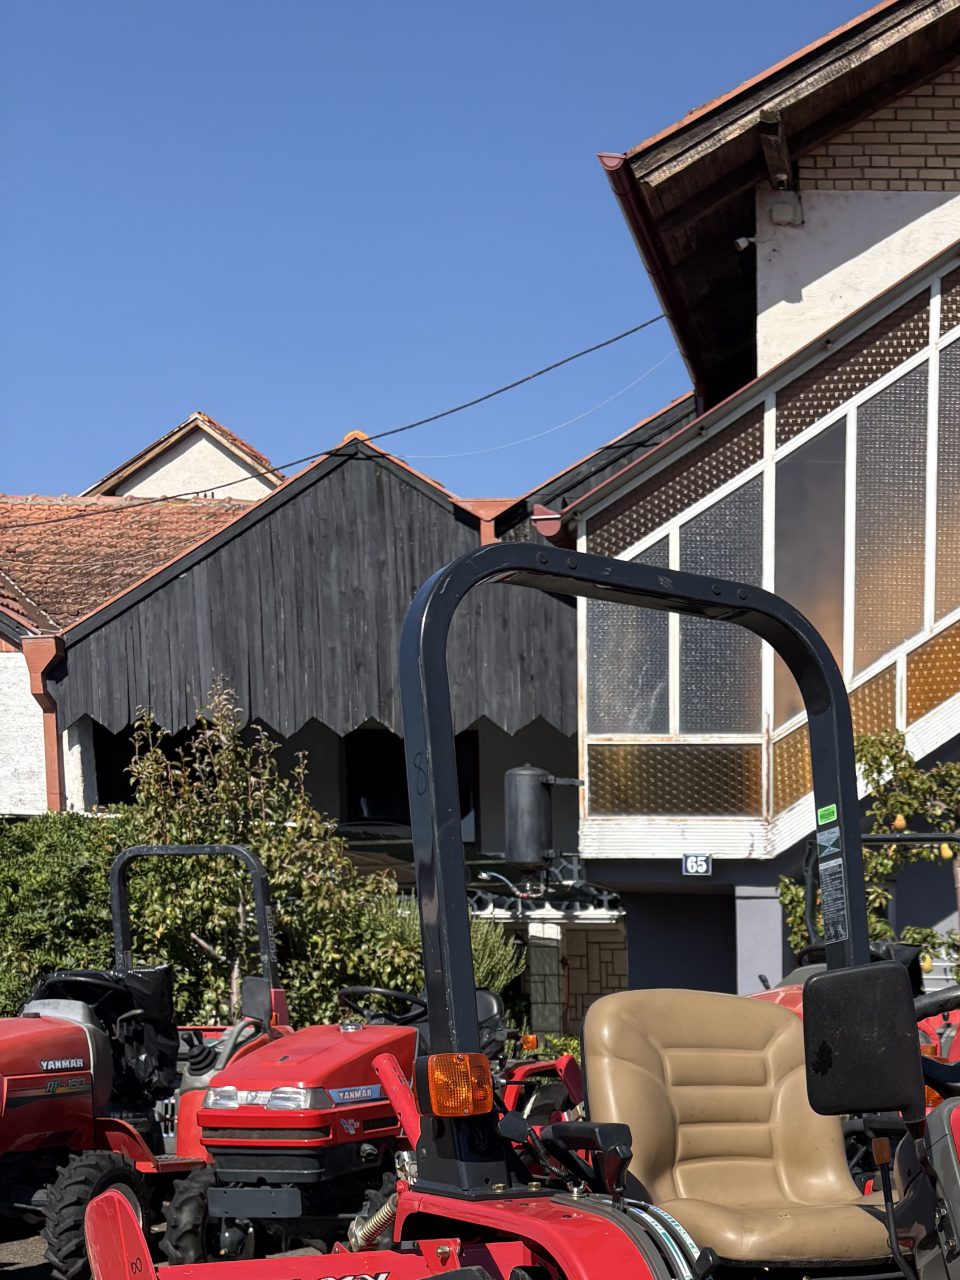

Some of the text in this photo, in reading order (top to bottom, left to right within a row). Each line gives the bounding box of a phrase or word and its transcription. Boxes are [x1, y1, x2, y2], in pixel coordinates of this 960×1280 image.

[412, 752, 428, 796] 8
[686, 855, 708, 873] 65
[40, 1058, 84, 1071] YANMAR
[338, 1088, 373, 1100] YANMAR
